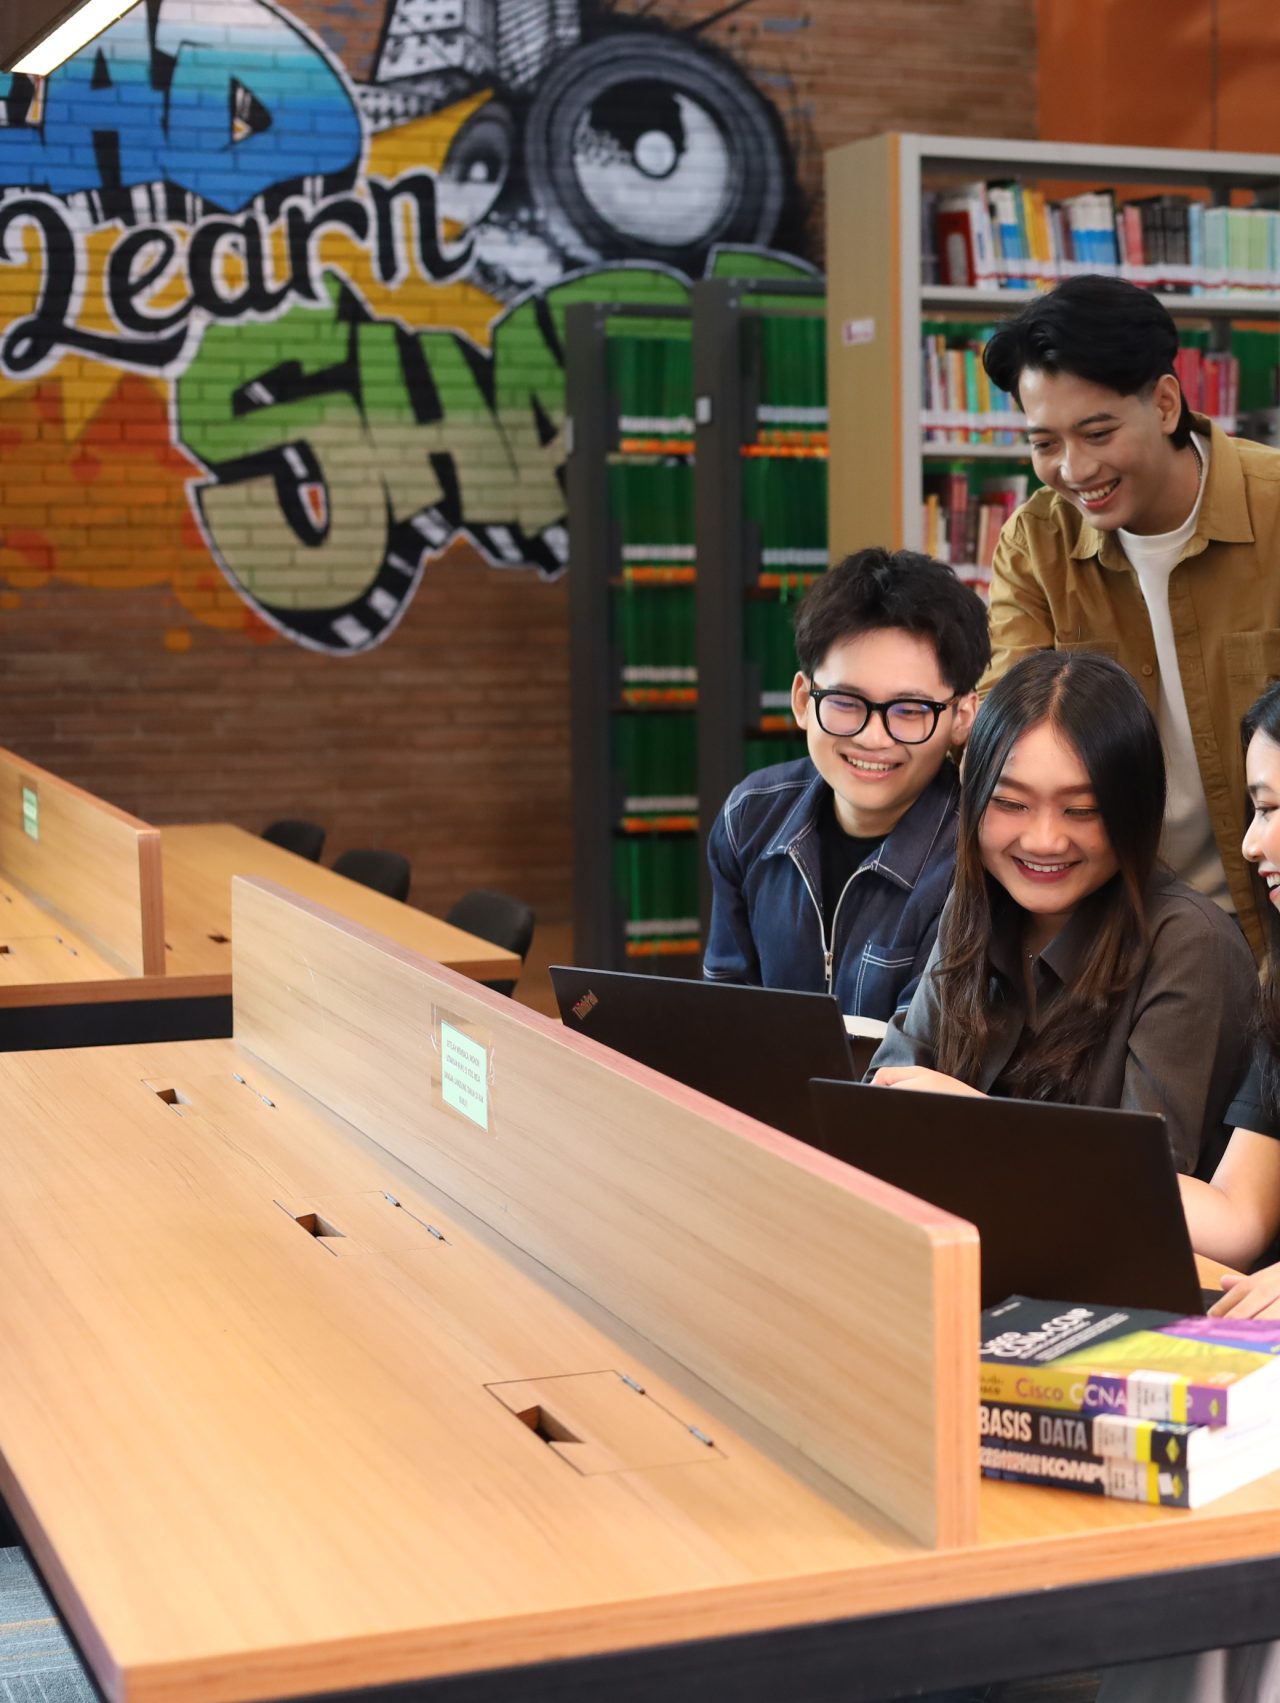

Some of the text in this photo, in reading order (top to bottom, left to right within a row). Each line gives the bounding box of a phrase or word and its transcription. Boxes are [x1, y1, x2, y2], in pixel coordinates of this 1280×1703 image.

[2, 174, 475, 371] Learn
[1015, 1377, 1064, 1402] Cisco
[1069, 1382, 1127, 1409] CCNA
[979, 1405, 1033, 1443] BASIS
[1038, 1415, 1089, 1452] DATA
[1040, 1454, 1103, 1484] KOMP
